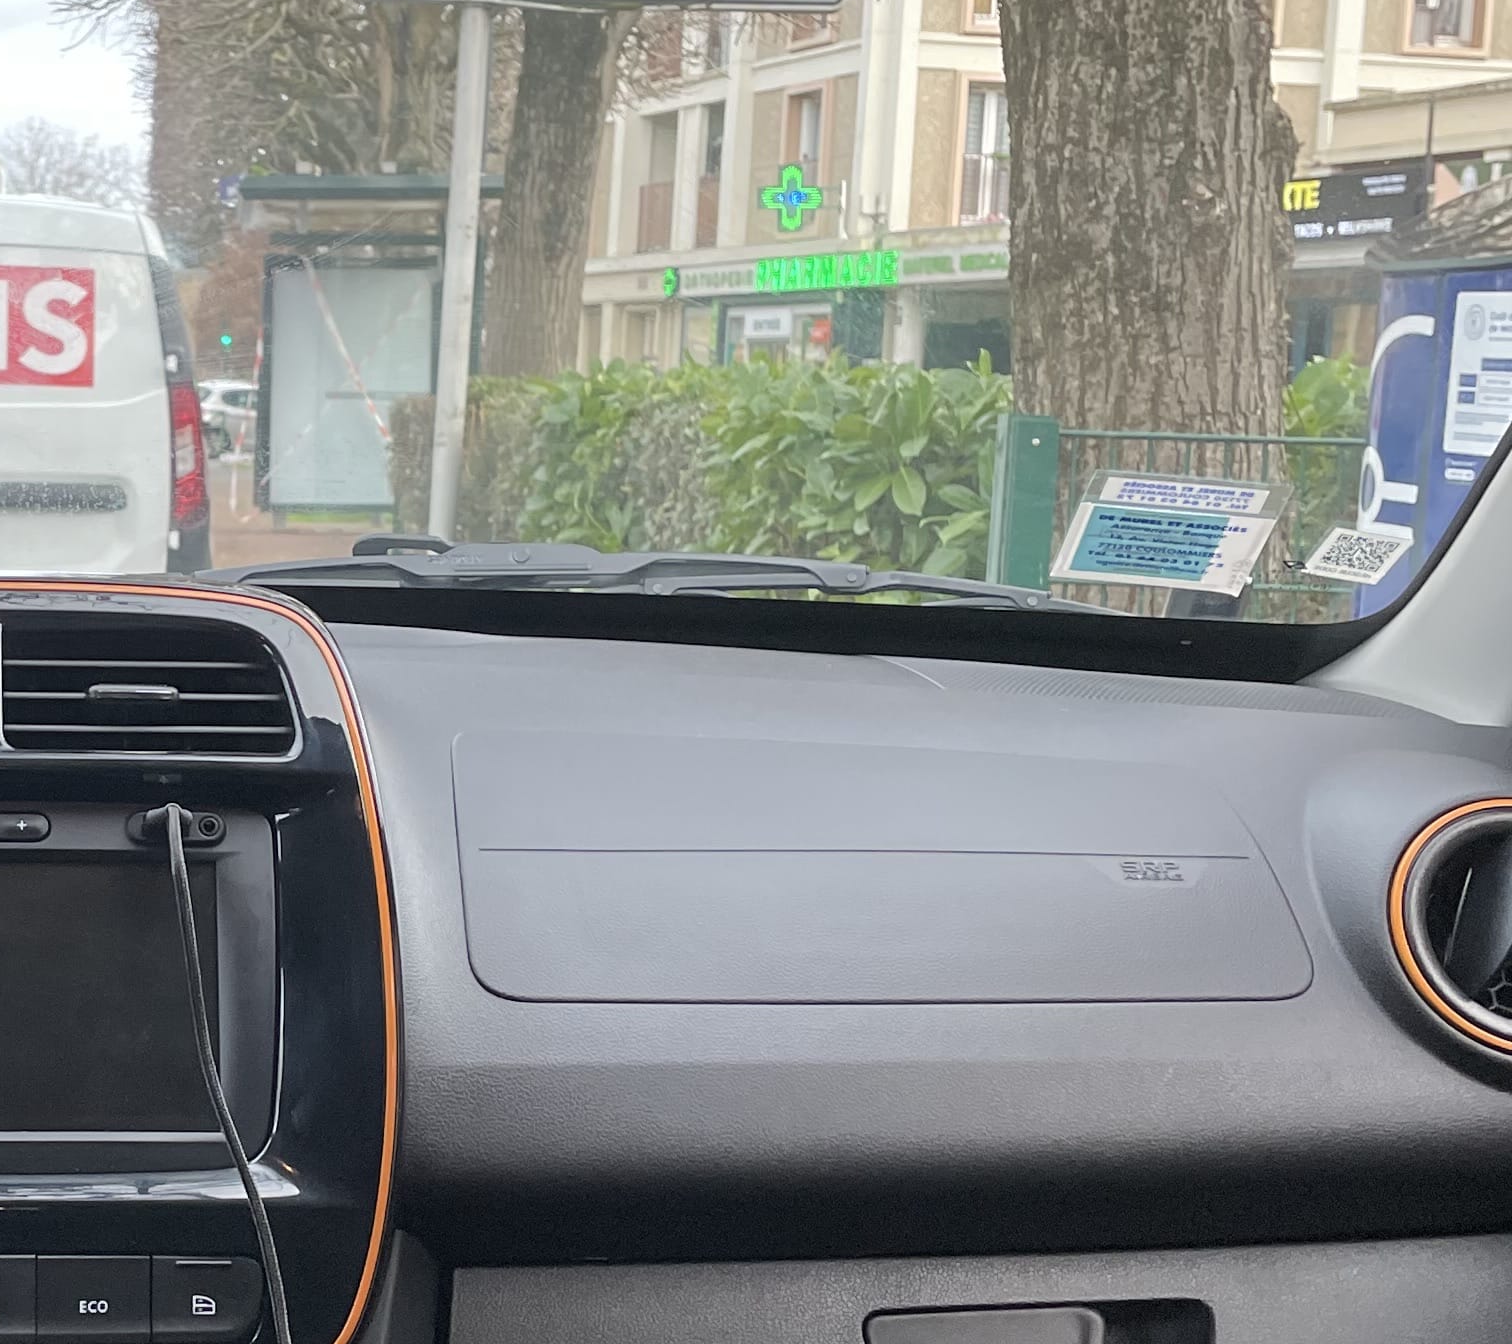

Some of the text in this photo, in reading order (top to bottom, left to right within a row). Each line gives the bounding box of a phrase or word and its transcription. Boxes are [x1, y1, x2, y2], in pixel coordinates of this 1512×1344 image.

[754, 250, 900, 291] PHARMACIE
[1120, 861, 1180, 873] SRP
[78, 1299, 109, 1314] ECO
